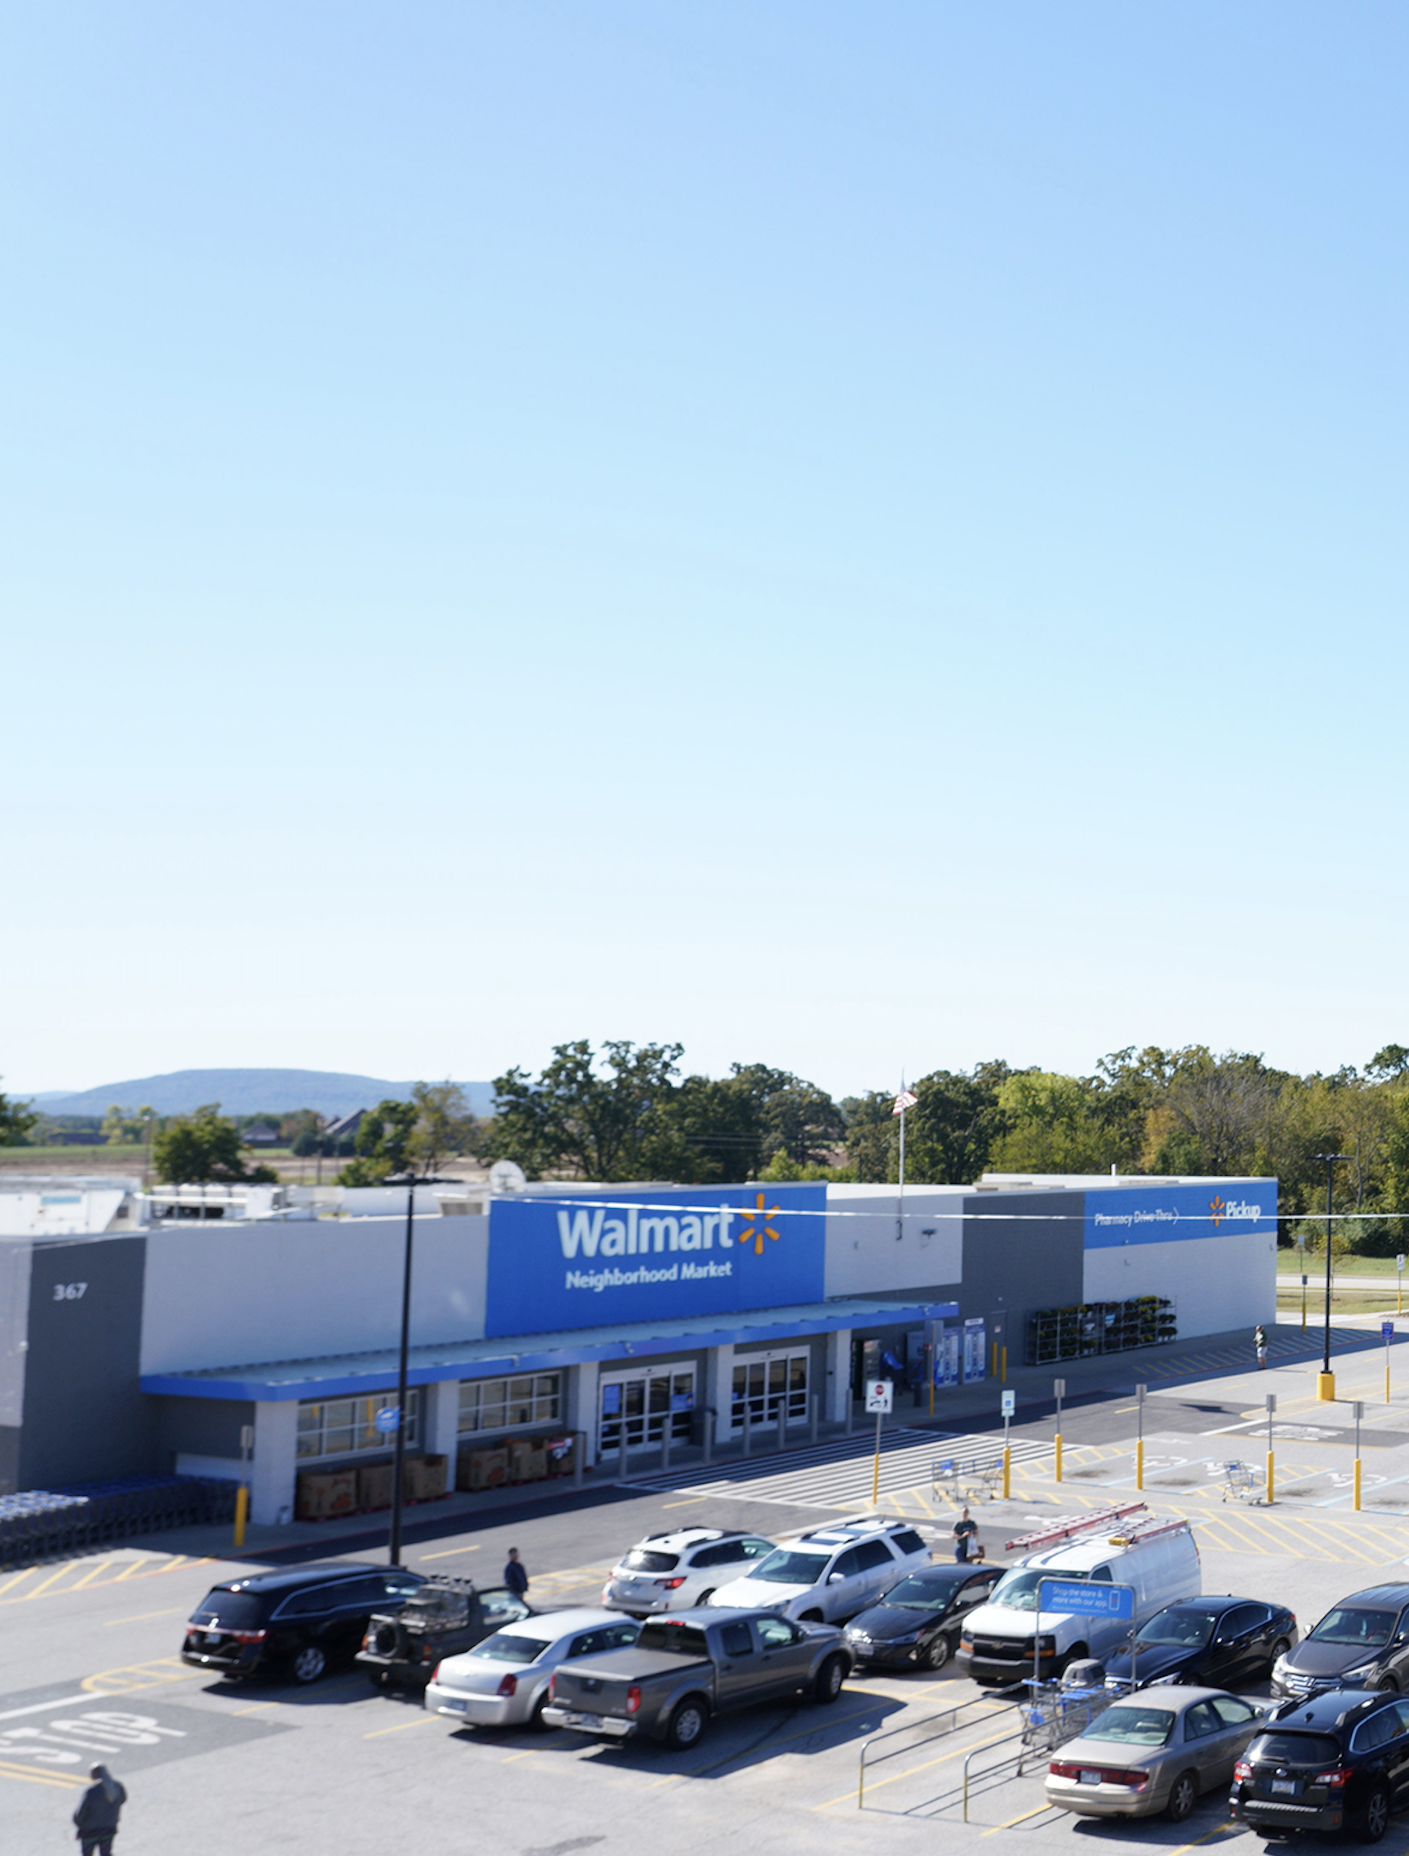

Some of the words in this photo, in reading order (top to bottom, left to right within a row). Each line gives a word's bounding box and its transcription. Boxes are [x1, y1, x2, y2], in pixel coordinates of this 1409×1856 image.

[1094, 1212, 1133, 1227] Pharmacy
[1226, 1201, 1261, 1223] Pickup
[557, 1203, 735, 1259] Walmart
[565, 1263, 678, 1292] Neighborhood
[680, 1260, 733, 1280] Market
[53, 1282, 88, 1301] 367
[0, 1711, 188, 1765] STOP
